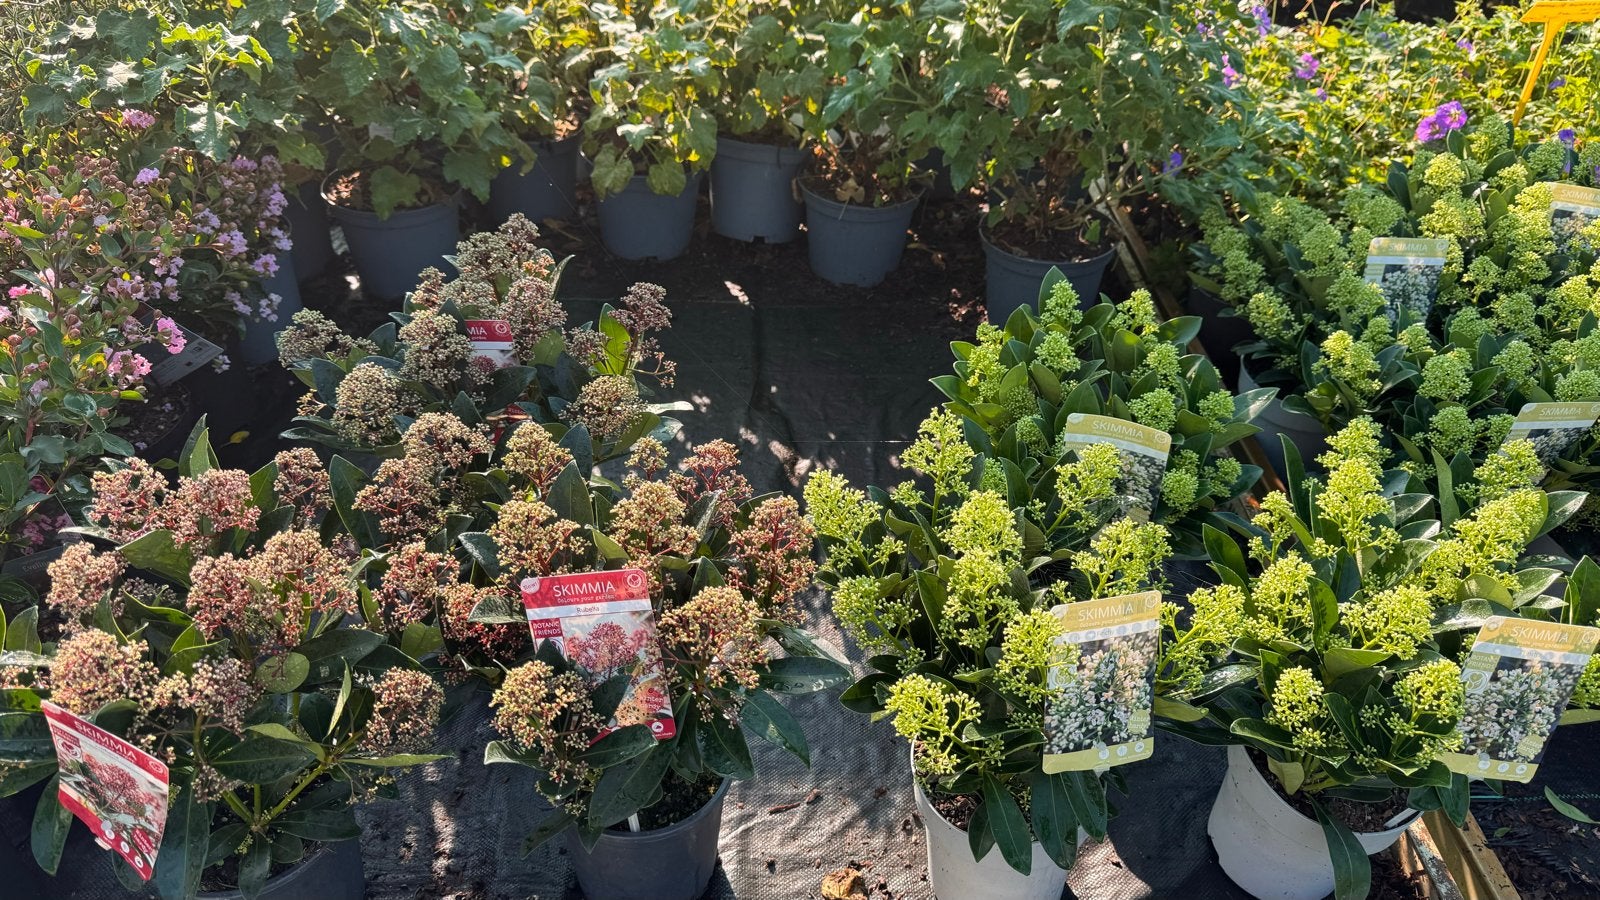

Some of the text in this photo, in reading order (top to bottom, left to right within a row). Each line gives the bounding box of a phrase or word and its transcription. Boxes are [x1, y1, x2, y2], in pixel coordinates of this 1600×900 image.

[1540, 407, 1582, 416] SKIMMIA
[1093, 420, 1144, 439] SKIMMIA
[553, 581, 616, 597] SKIMMIA
[1079, 603, 1134, 620] SKIMMIA
[533, 621, 560, 629] BOTANIC
[534, 628, 561, 636] FRIENDS
[1511, 626, 1569, 642] SKIMMIA
[74, 720, 137, 761] SKIMMIA
